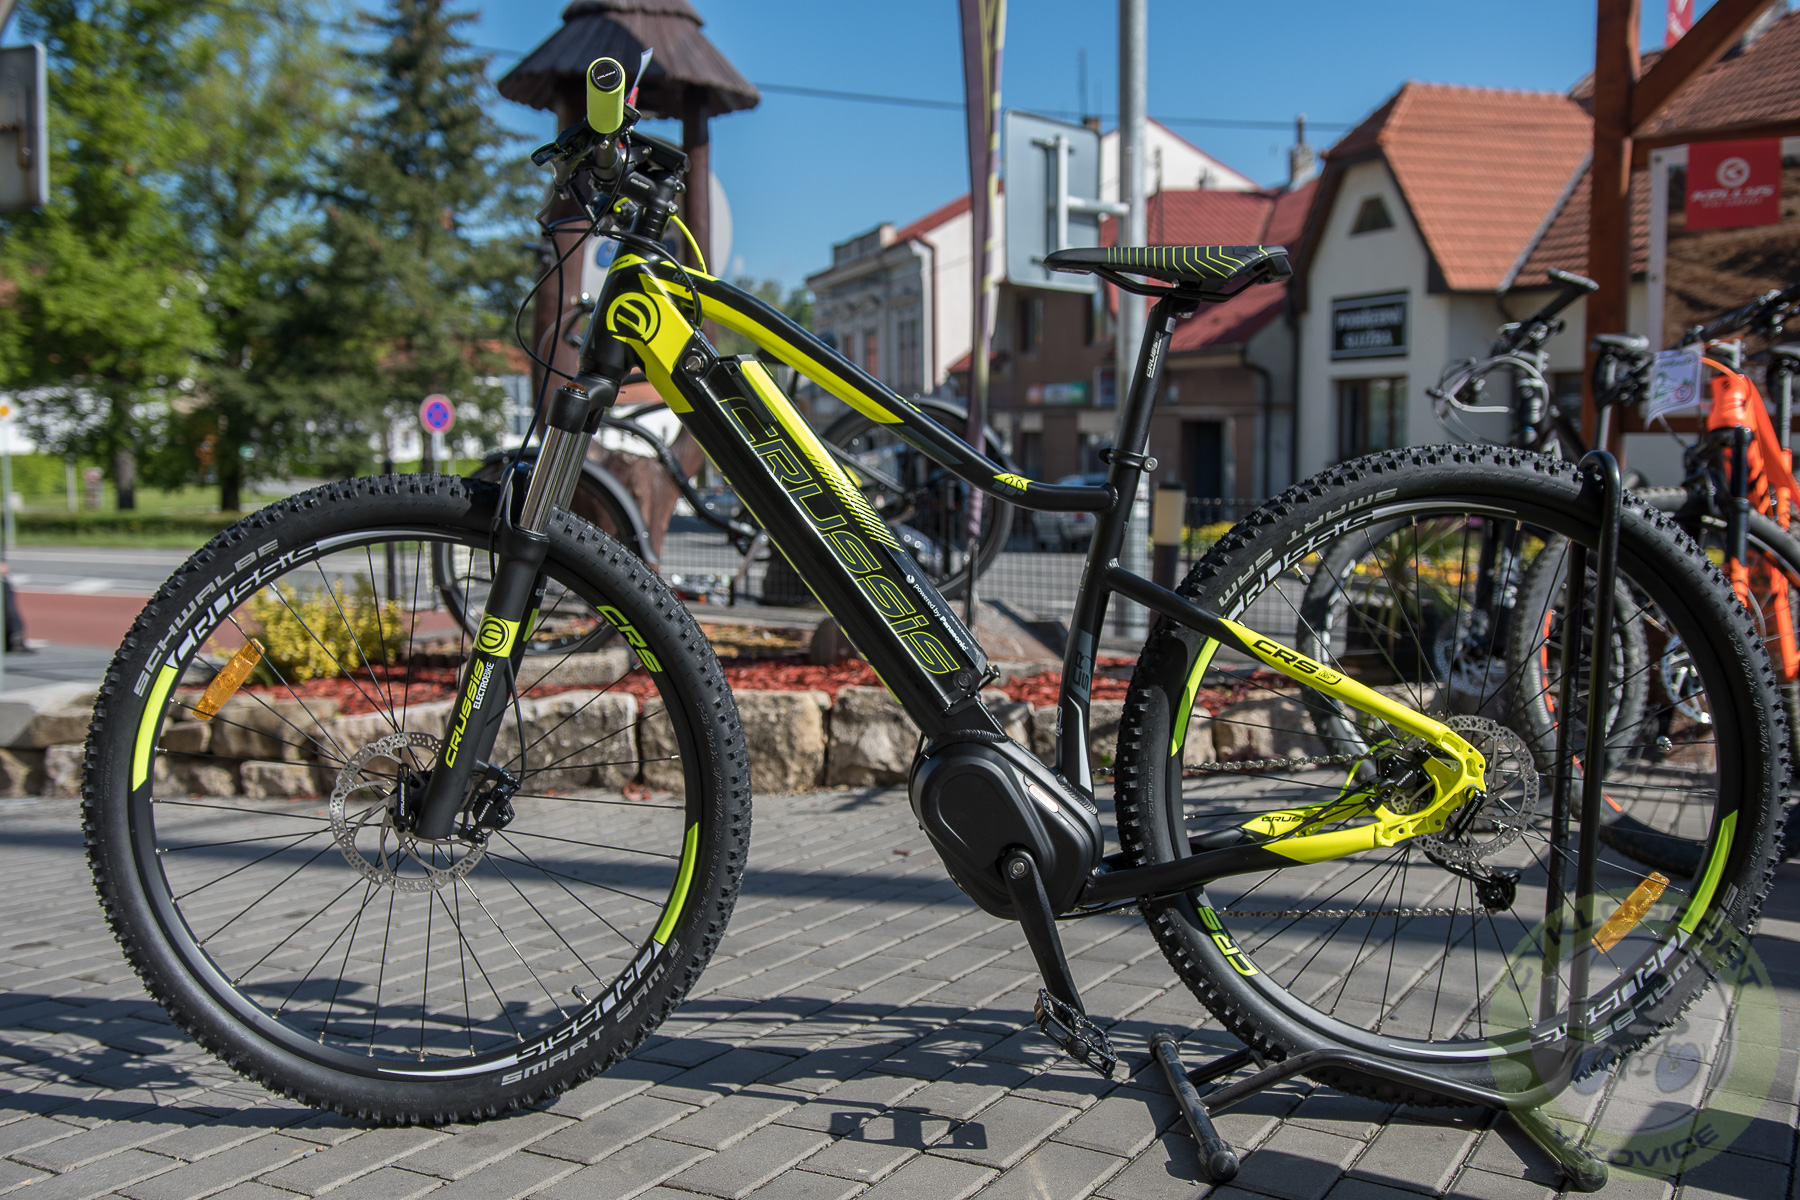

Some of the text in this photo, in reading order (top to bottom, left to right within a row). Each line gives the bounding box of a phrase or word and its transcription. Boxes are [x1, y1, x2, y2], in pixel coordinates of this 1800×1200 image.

[1218, 487, 1398, 607] SMART SAM
[133, 539, 279, 697] SCHWALBE
[596, 605, 663, 673] CRS
[913, 583, 935, 609] powered
[940, 615, 967, 651] Panasonic
[473, 661, 495, 710] ELECTROBIKE
[1251, 639, 1319, 675] CRS
[1197, 906, 1260, 977] CRS
[1592, 882, 1739, 1044] SCHWALBE
[501, 1025, 604, 1087] SMART
[615, 962, 665, 1023] SAM
